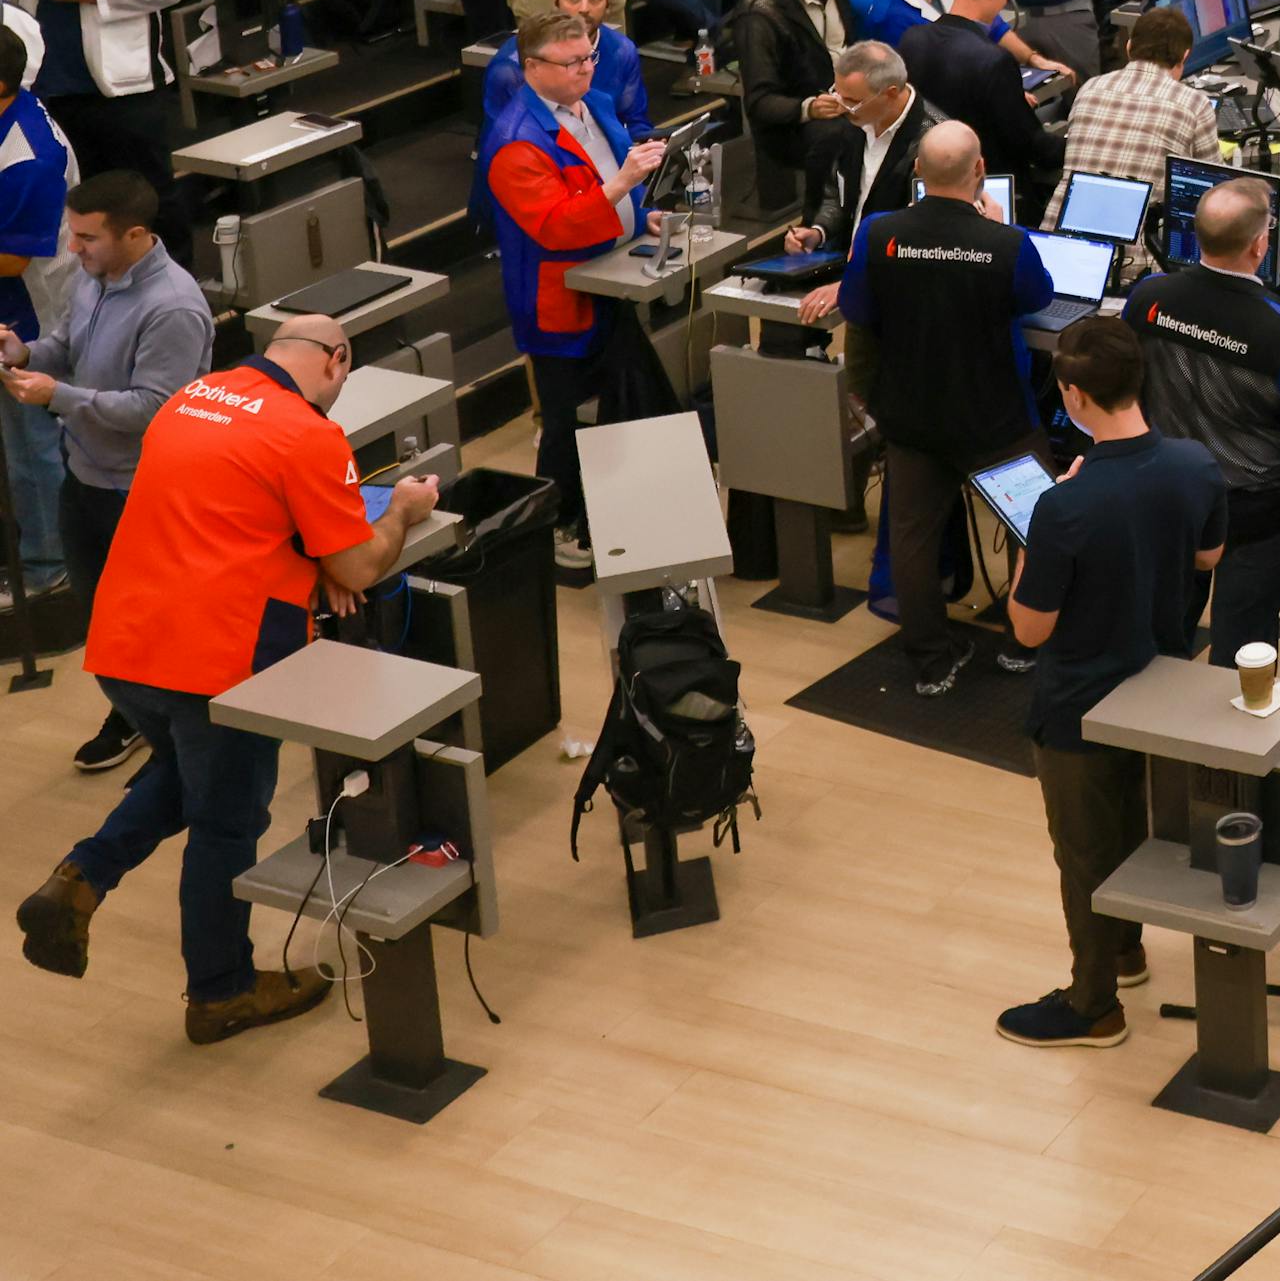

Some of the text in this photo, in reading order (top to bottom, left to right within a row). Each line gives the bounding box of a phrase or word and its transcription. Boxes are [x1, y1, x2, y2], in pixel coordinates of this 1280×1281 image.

[897, 245, 993, 264] InteractiveBrokers
[1156, 310, 1249, 356] InteractiveBrokers
[184, 378, 246, 412] Optiver
[177, 403, 232, 426] Amsterdam
